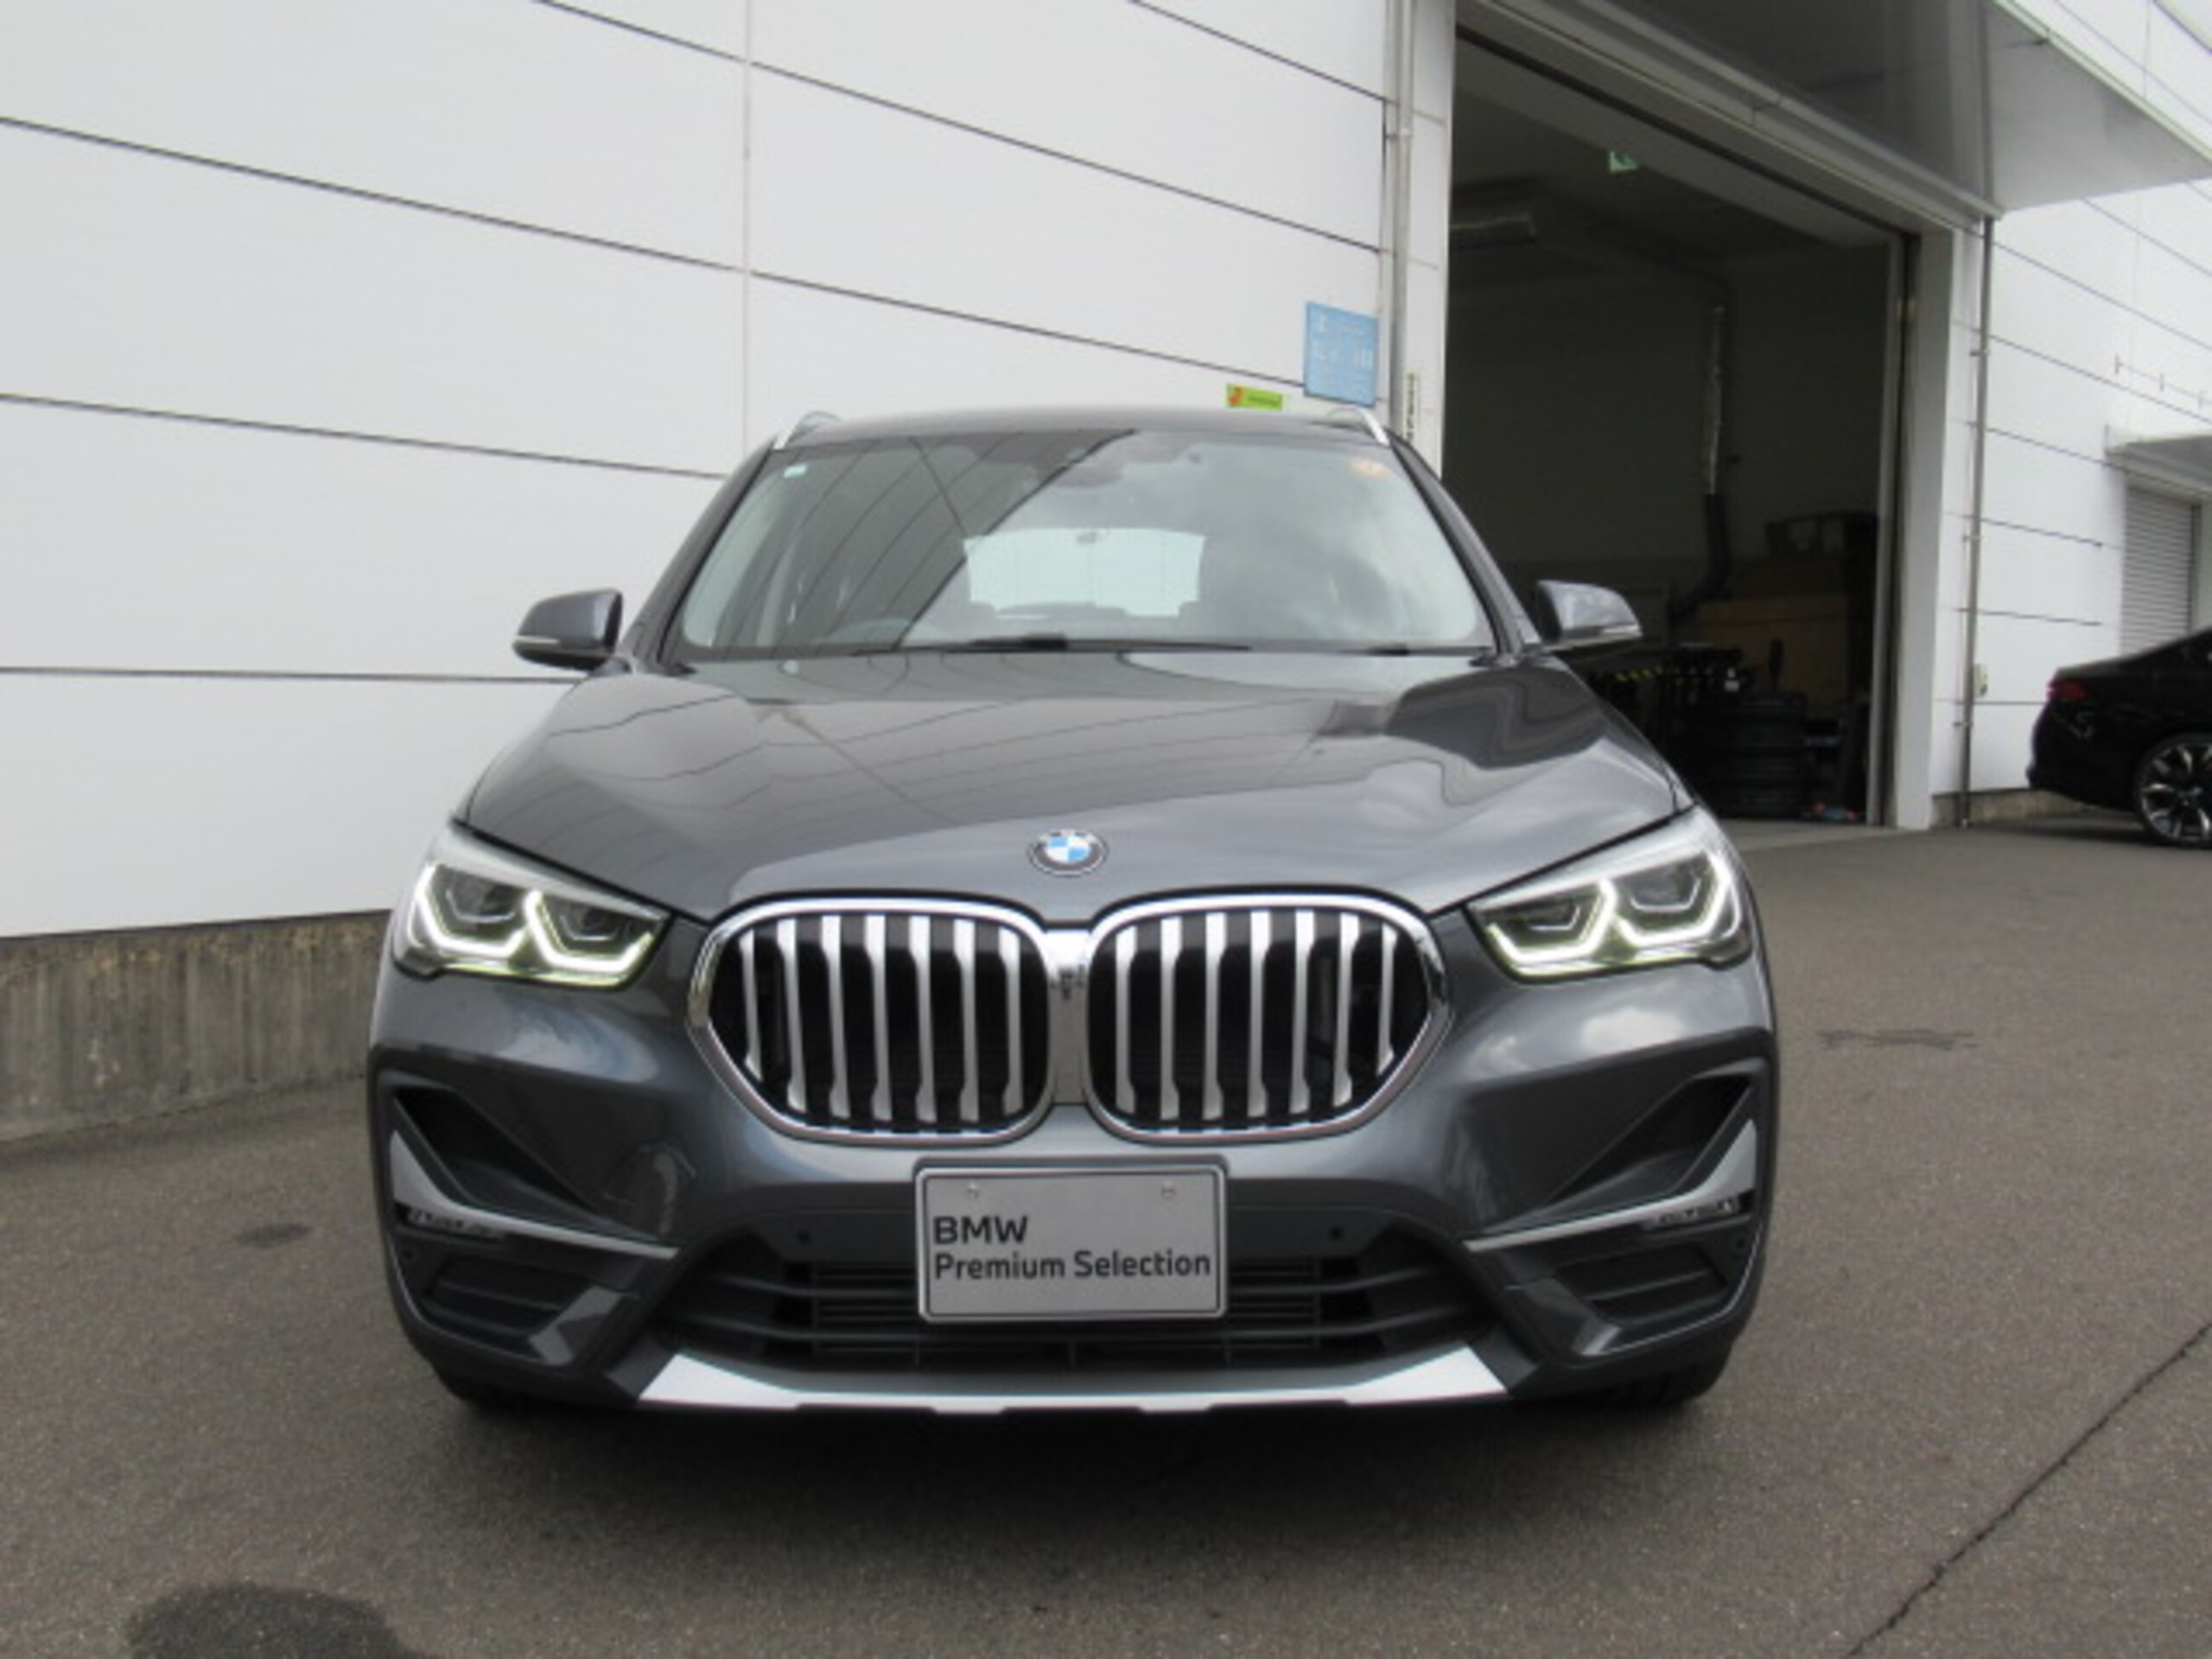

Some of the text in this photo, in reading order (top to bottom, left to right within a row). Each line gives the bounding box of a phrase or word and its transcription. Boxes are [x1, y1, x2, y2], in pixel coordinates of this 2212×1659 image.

[933, 1214, 1028, 1245] BMW
[934, 1249, 1211, 1280] Premium Selection
